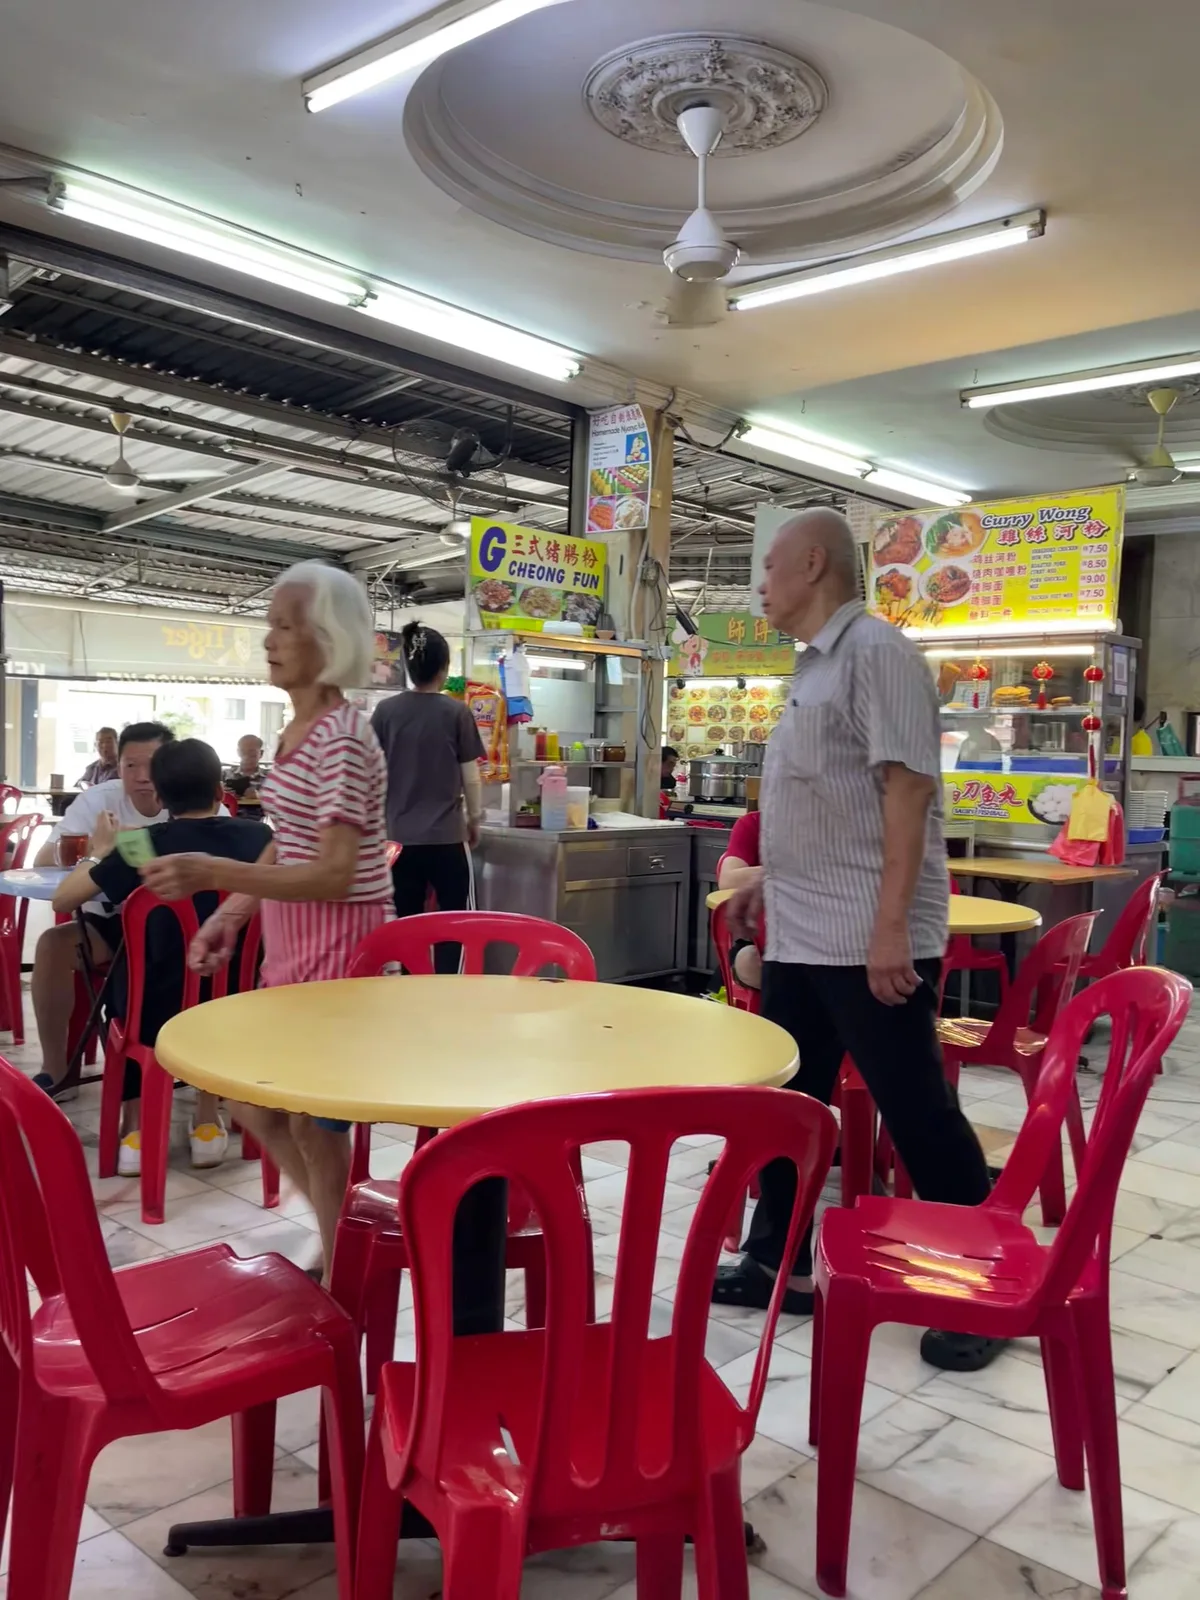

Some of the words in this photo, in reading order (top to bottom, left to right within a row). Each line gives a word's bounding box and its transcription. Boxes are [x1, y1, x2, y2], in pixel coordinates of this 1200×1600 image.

[981, 513, 1033, 529] Curry
[1038, 505, 1092, 523] Wong
[479, 526, 507, 572] G
[509, 560, 566, 584] CHEONG
[572, 571, 600, 590] FUN
